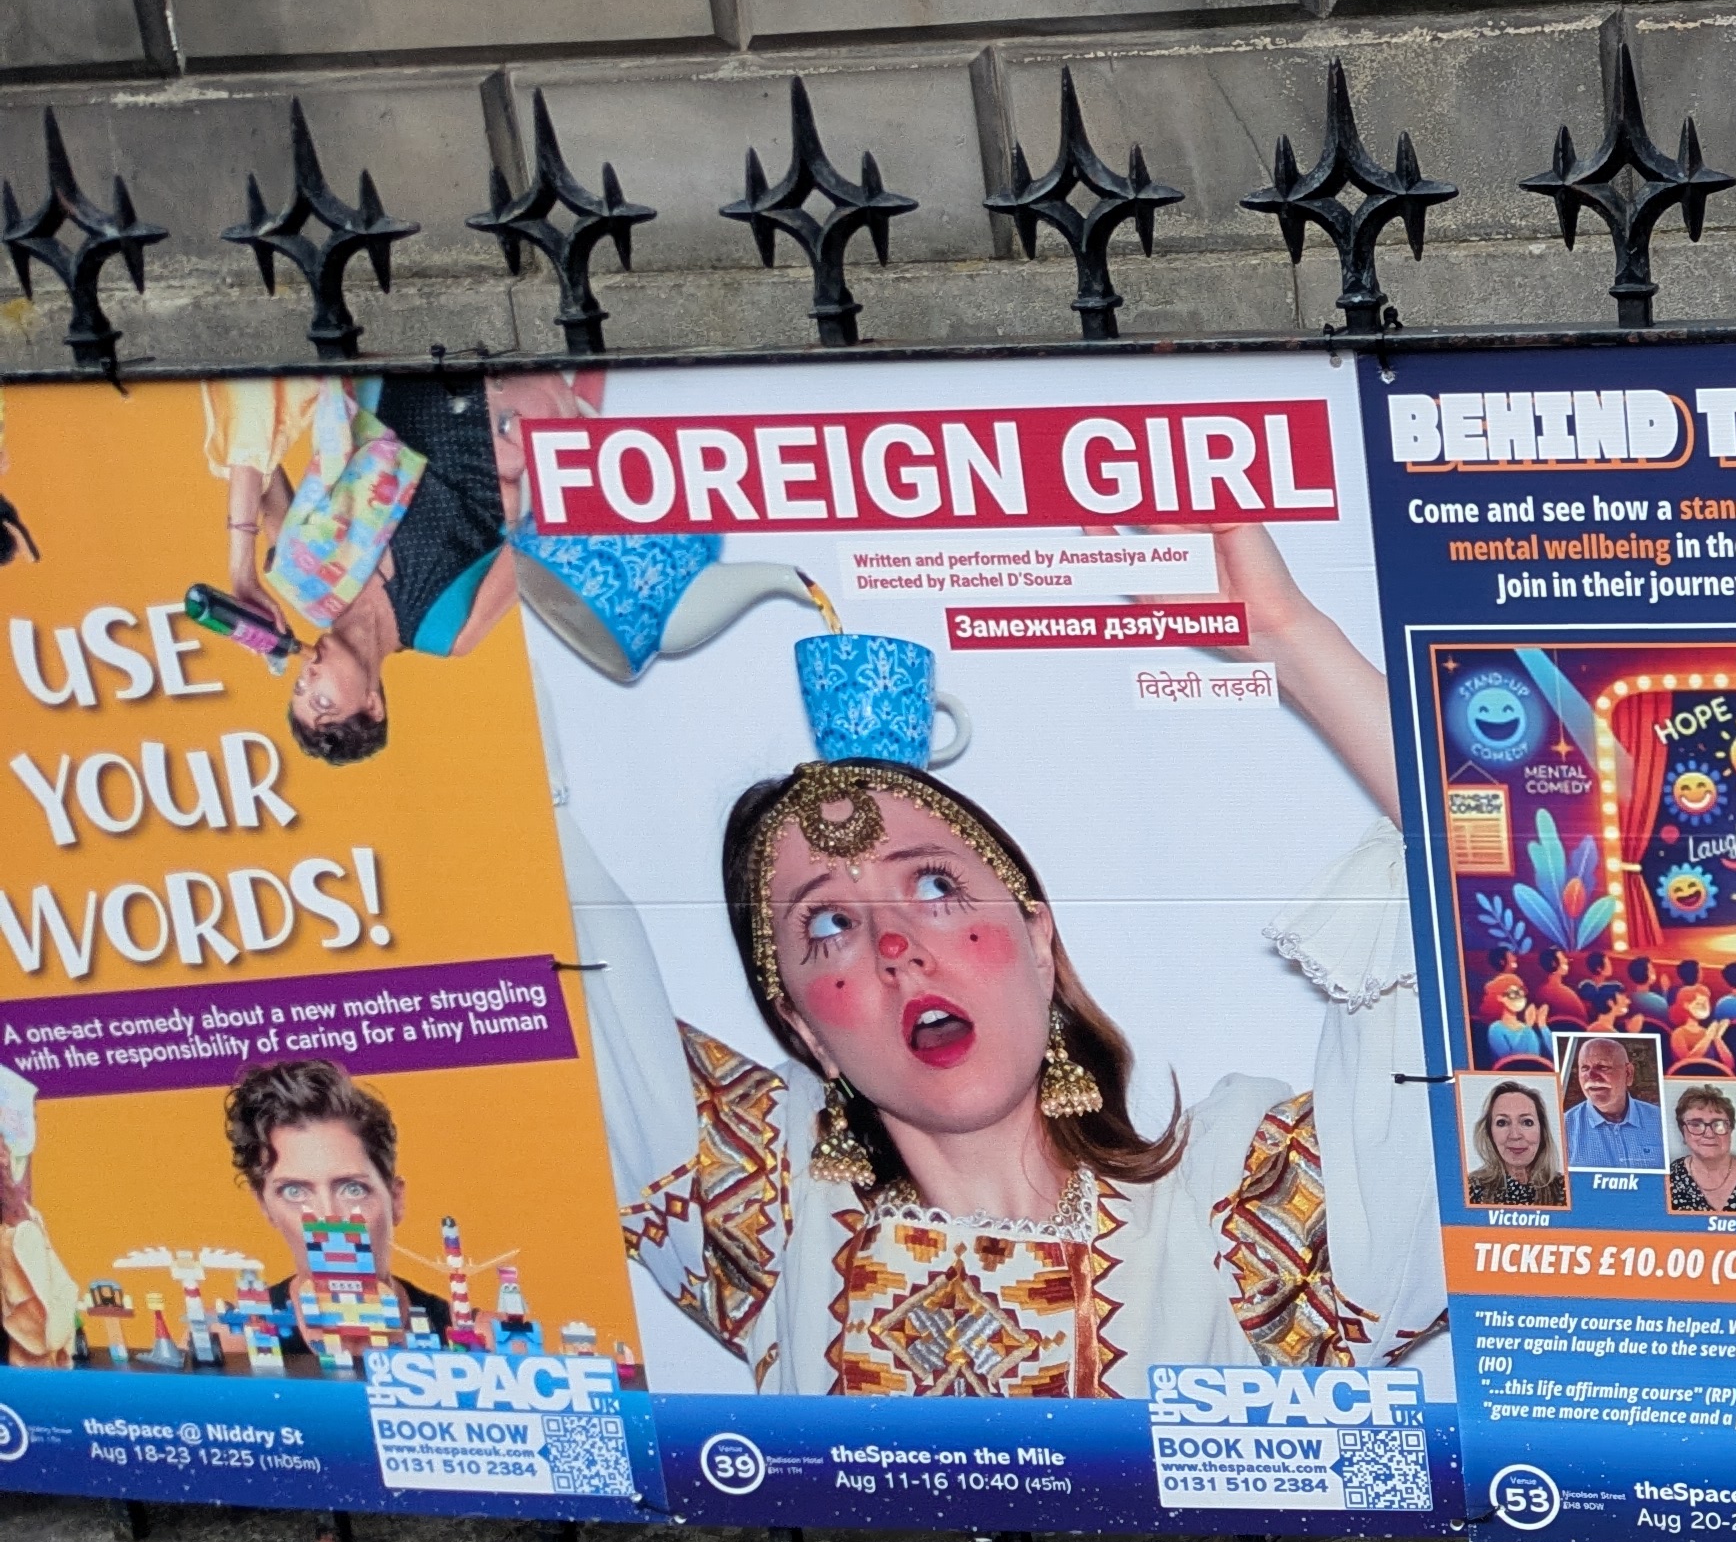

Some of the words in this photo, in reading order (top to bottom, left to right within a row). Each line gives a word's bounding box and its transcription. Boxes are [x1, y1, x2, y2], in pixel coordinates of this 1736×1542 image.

[1388, 390, 1678, 462] BEHIND
[530, 422, 1028, 524] FOREIGN
[1061, 413, 1336, 515] GIRL
[1409, 499, 1479, 523] Come
[1488, 496, 1534, 522] and
[1543, 502, 1585, 521] see
[1593, 495, 1648, 521] how
[1657, 501, 1672, 520] a
[854, 554, 911, 567] Written
[916, 552, 944, 566] and
[948, 548, 1032, 571] performed
[1035, 550, 1053, 568] by
[1059, 549, 1146, 566] Anastasiya
[1151, 547, 1188, 562] Ador
[1450, 535, 1538, 560] mental
[1544, 533, 1671, 565] wellbeing
[1676, 533, 1700, 558] in
[857, 574, 923, 589] Directed
[927, 574, 945, 591] by
[950, 573, 1003, 587] Rachel
[1008, 572, 1072, 586] D'Souza
[1497, 572, 1547, 604] Join
[1553, 572, 1577, 597] in
[1582, 571, 1644, 597] their
[955, 615, 1096, 637] Замежная
[1104, 611, 1239, 640] дзяўчына
[1136, 671, 1202, 702] विदेशी
[1209, 670, 1272, 701] लड़की
[1459, 672, 1531, 699] STAND-UP
[1654, 696, 1734, 744] HOPE
[1471, 741, 1529, 761] COMEDY
[1524, 765, 1587, 779] MENTAL
[11, 732, 297, 847] YOUR
[1525, 780, 1593, 795] COMEDY
[0, 847, 392, 980] WORDS!
[4, 1025, 21, 1045] A
[27, 1019, 103, 1042] one-act
[109, 1011, 194, 1037] comedy
[201, 1004, 265, 1029] about
[272, 1009, 285, 1023] a
[291, 1004, 336, 1021] new
[343, 991, 423, 1018] mother
[429, 980, 546, 1020] struggling
[15, 1050, 60, 1072] with
[65, 1045, 100, 1067] the
[106, 1034, 249, 1068] responsibility
[257, 1030, 279, 1053] of
[286, 1027, 357, 1051] caring
[362, 1024, 395, 1044] for
[403, 1026, 417, 1040] a
[422, 1019, 463, 1042] tiny
[469, 1015, 548, 1035] human
[1593, 1173, 1639, 1191] Frank
[1488, 1209, 1550, 1227] Victoria
[1475, 1243, 1592, 1274] TICKETS
[1599, 1247, 1704, 1278] £10.00
[715, 1455, 756, 1478] 39
